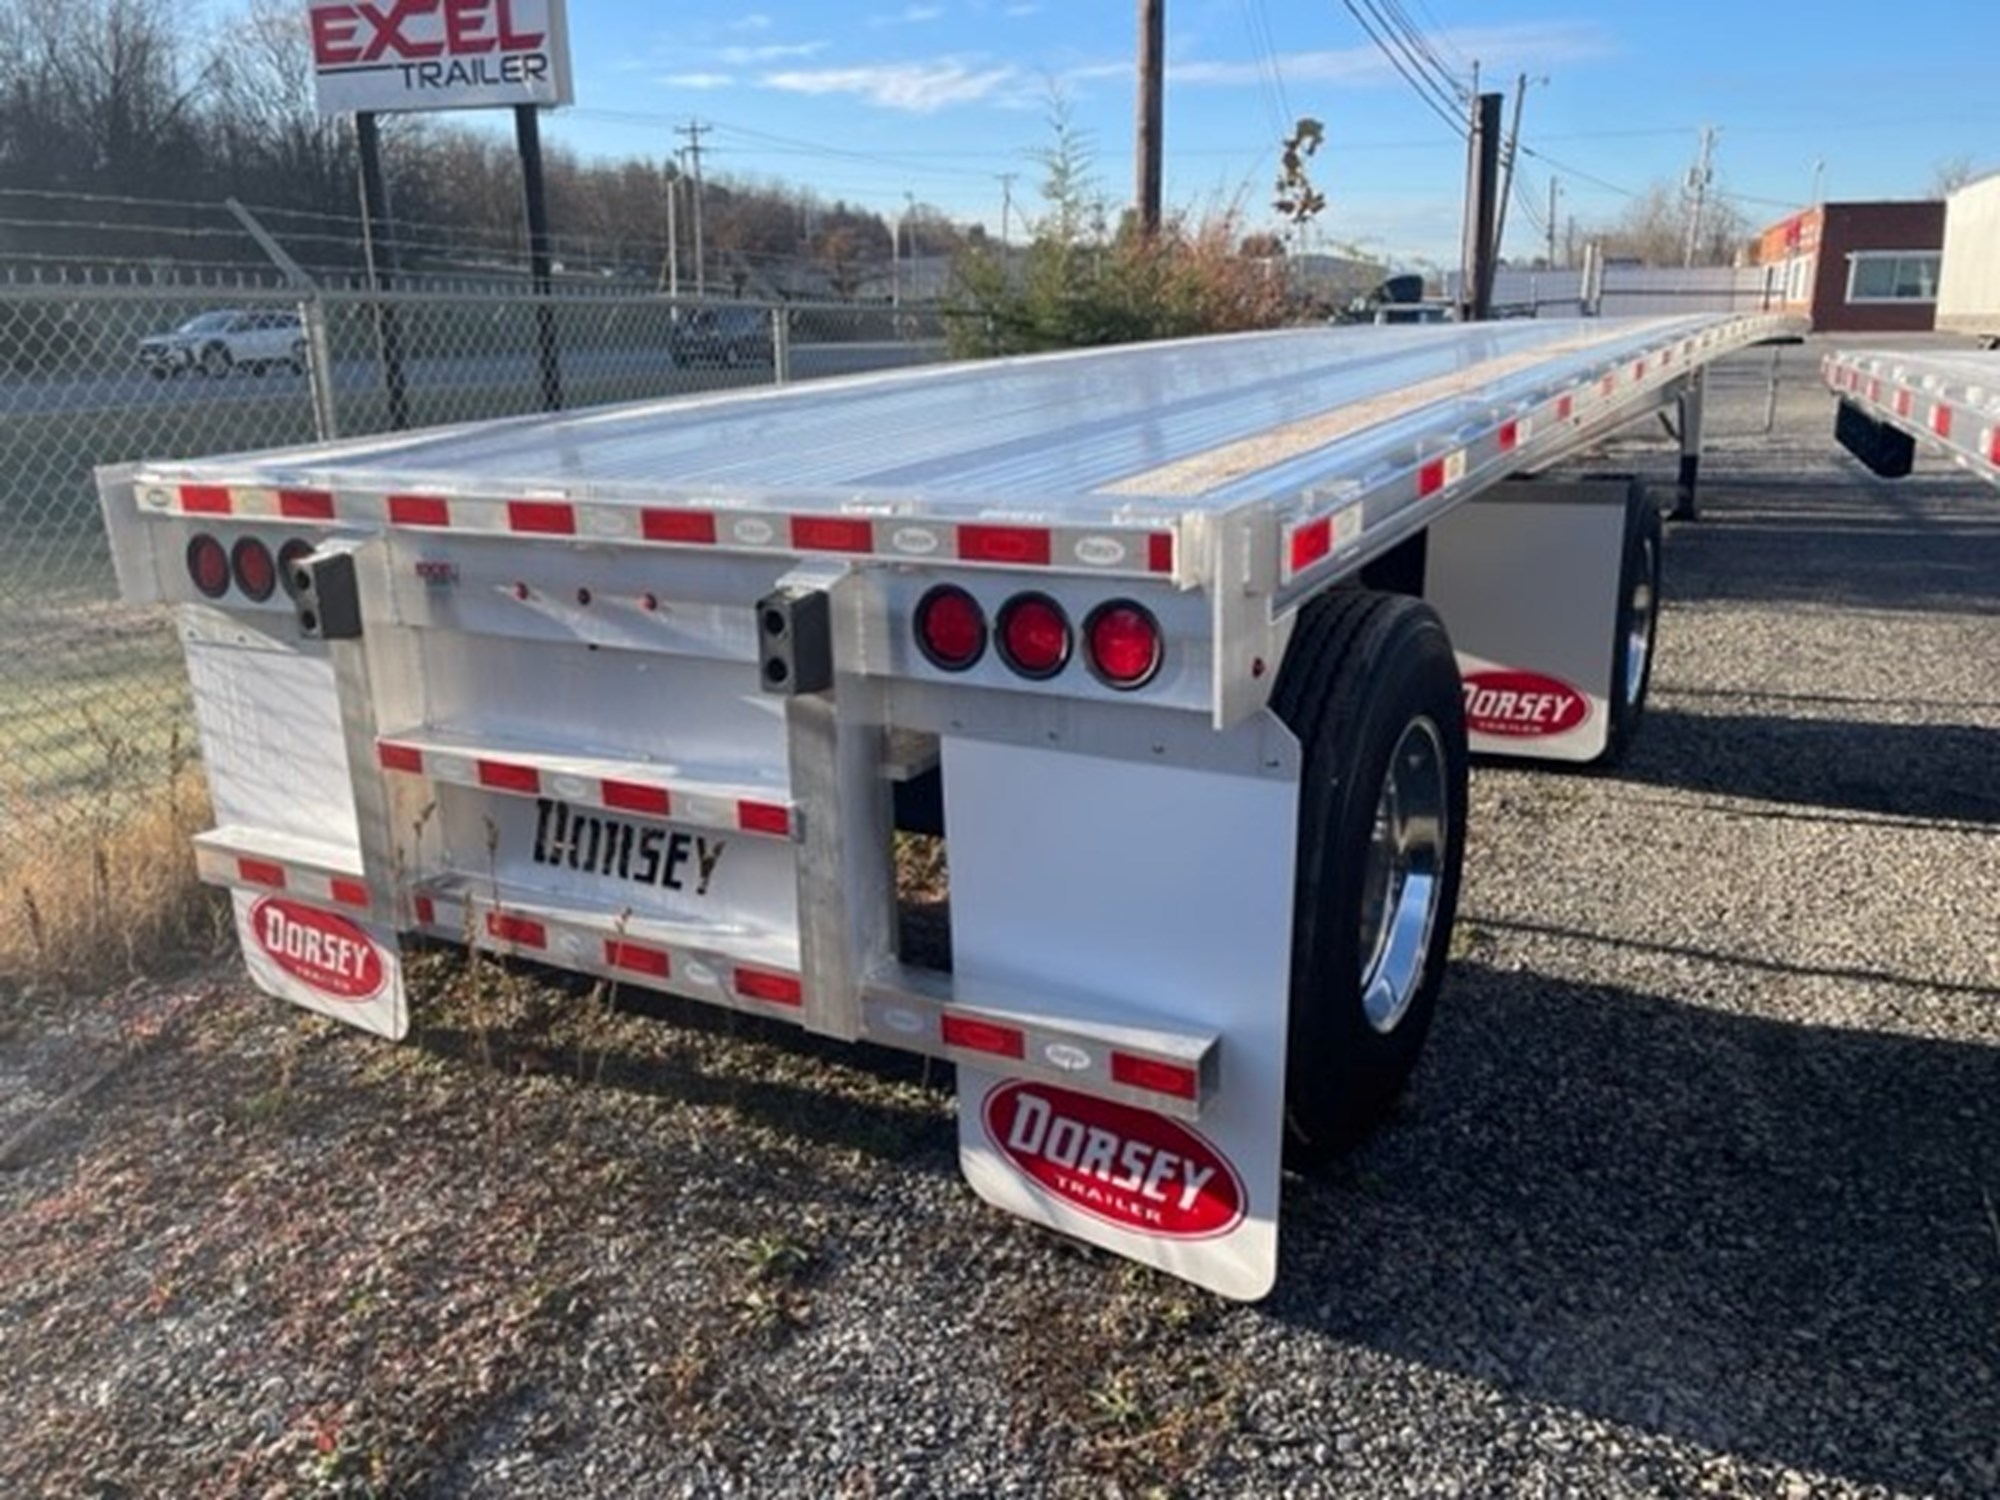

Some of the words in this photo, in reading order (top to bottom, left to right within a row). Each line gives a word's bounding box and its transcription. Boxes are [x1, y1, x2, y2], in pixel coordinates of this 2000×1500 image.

[310, 0, 545, 64] EXCEL
[398, 53, 548, 89] TRAILER
[533, 797, 726, 895] DORSEY
[264, 906, 369, 980] DORSEY
[1008, 1092, 1215, 1211] DORSEY
[1053, 1173, 1163, 1224] TRAILER
